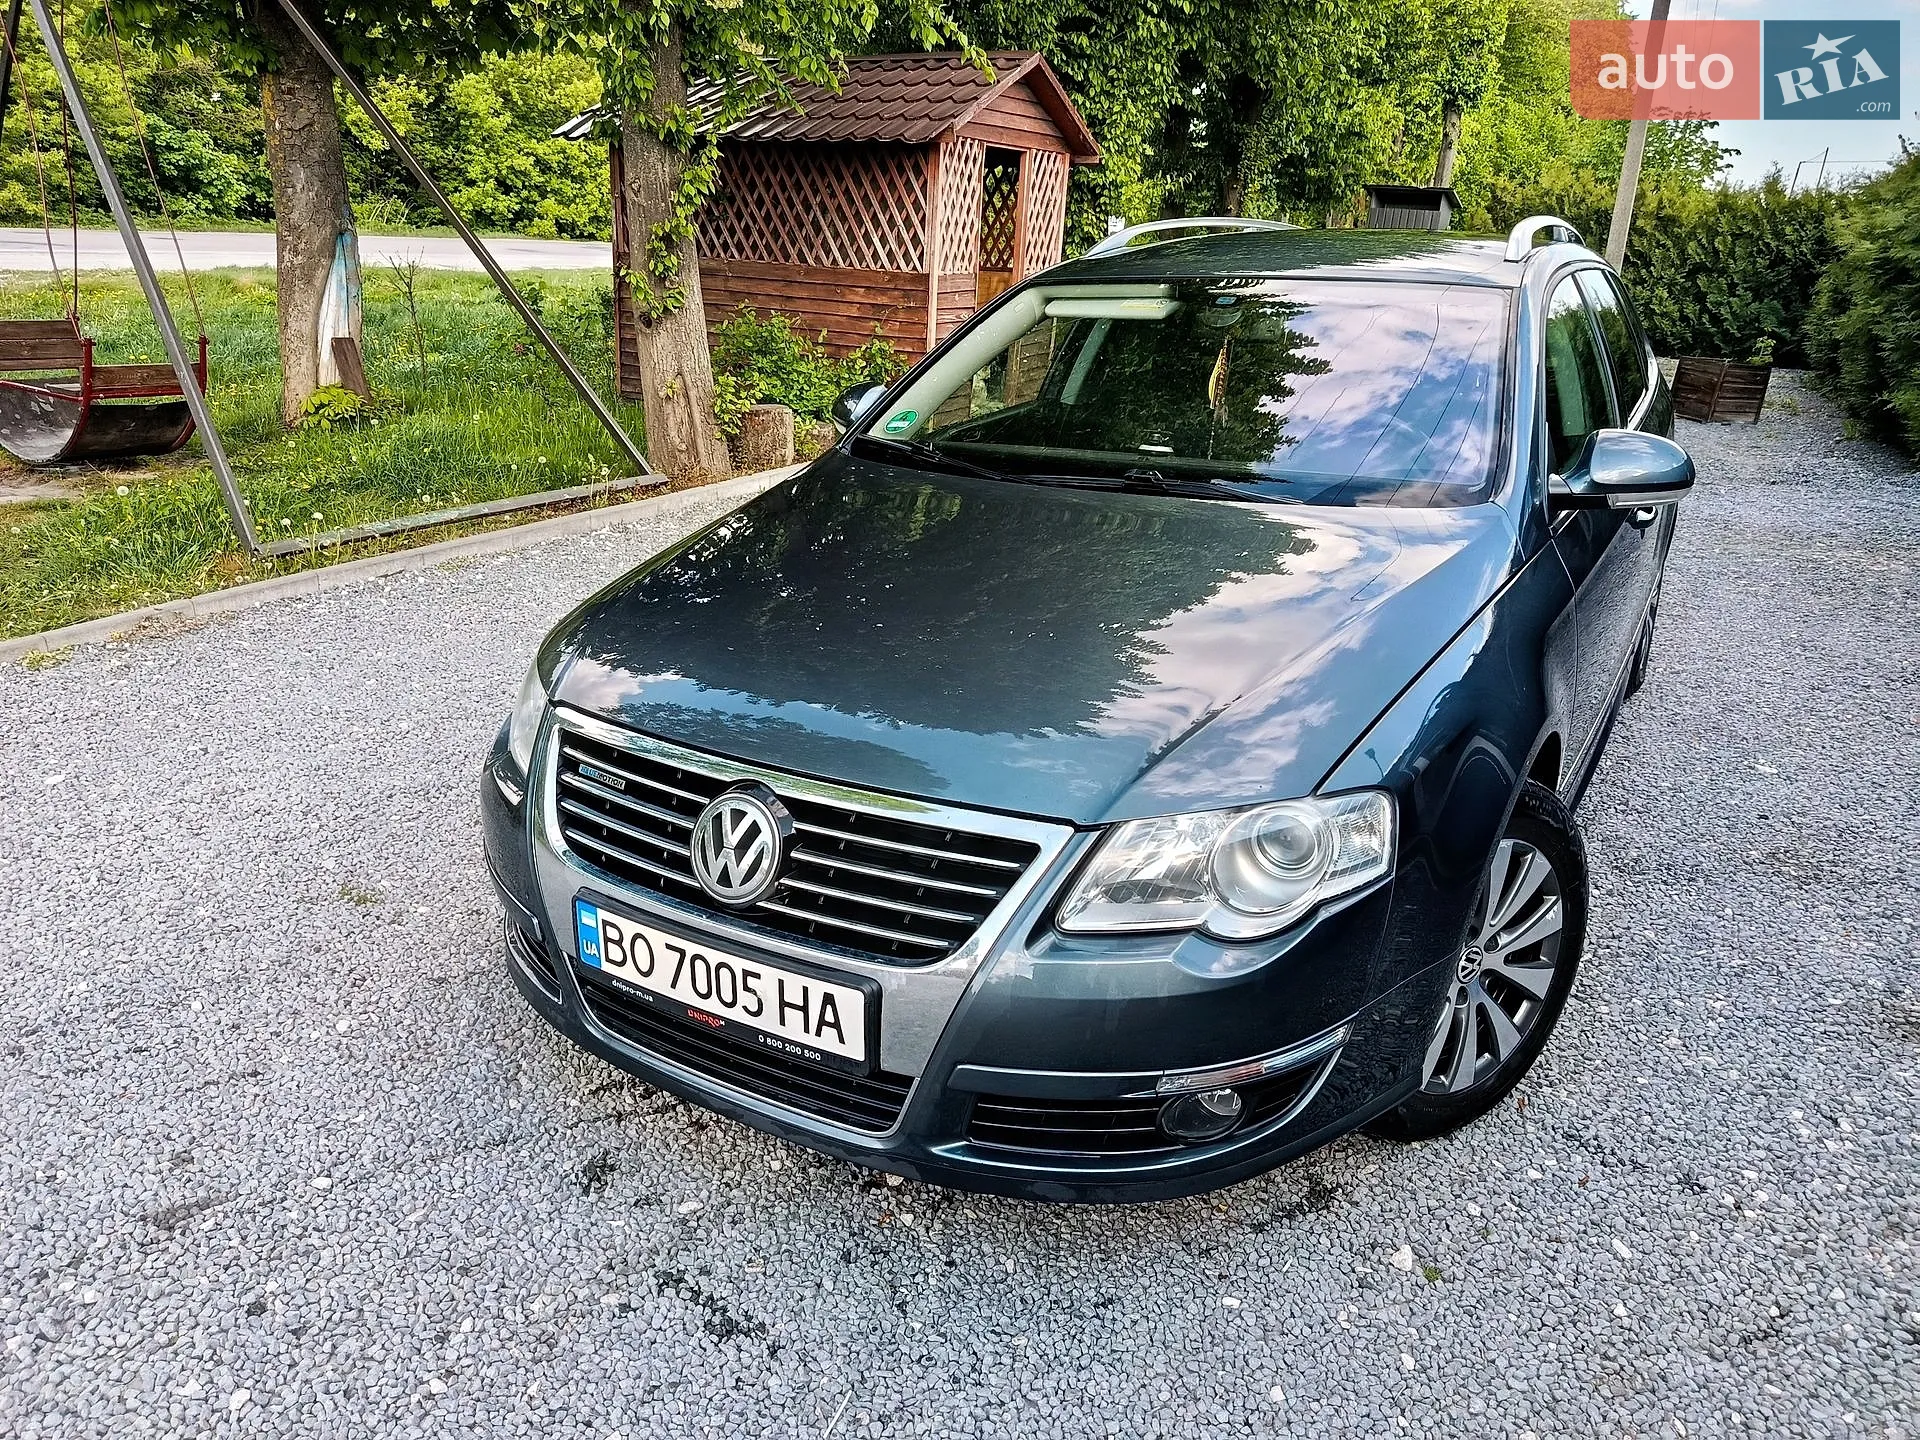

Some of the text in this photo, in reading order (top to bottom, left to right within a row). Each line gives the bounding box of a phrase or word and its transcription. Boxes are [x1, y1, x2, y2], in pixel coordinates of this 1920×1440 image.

[583, 938, 599, 957] UA
[601, 919, 846, 1045] BO 7005 HA
[758, 1034, 821, 1061] 0 800 200 500
